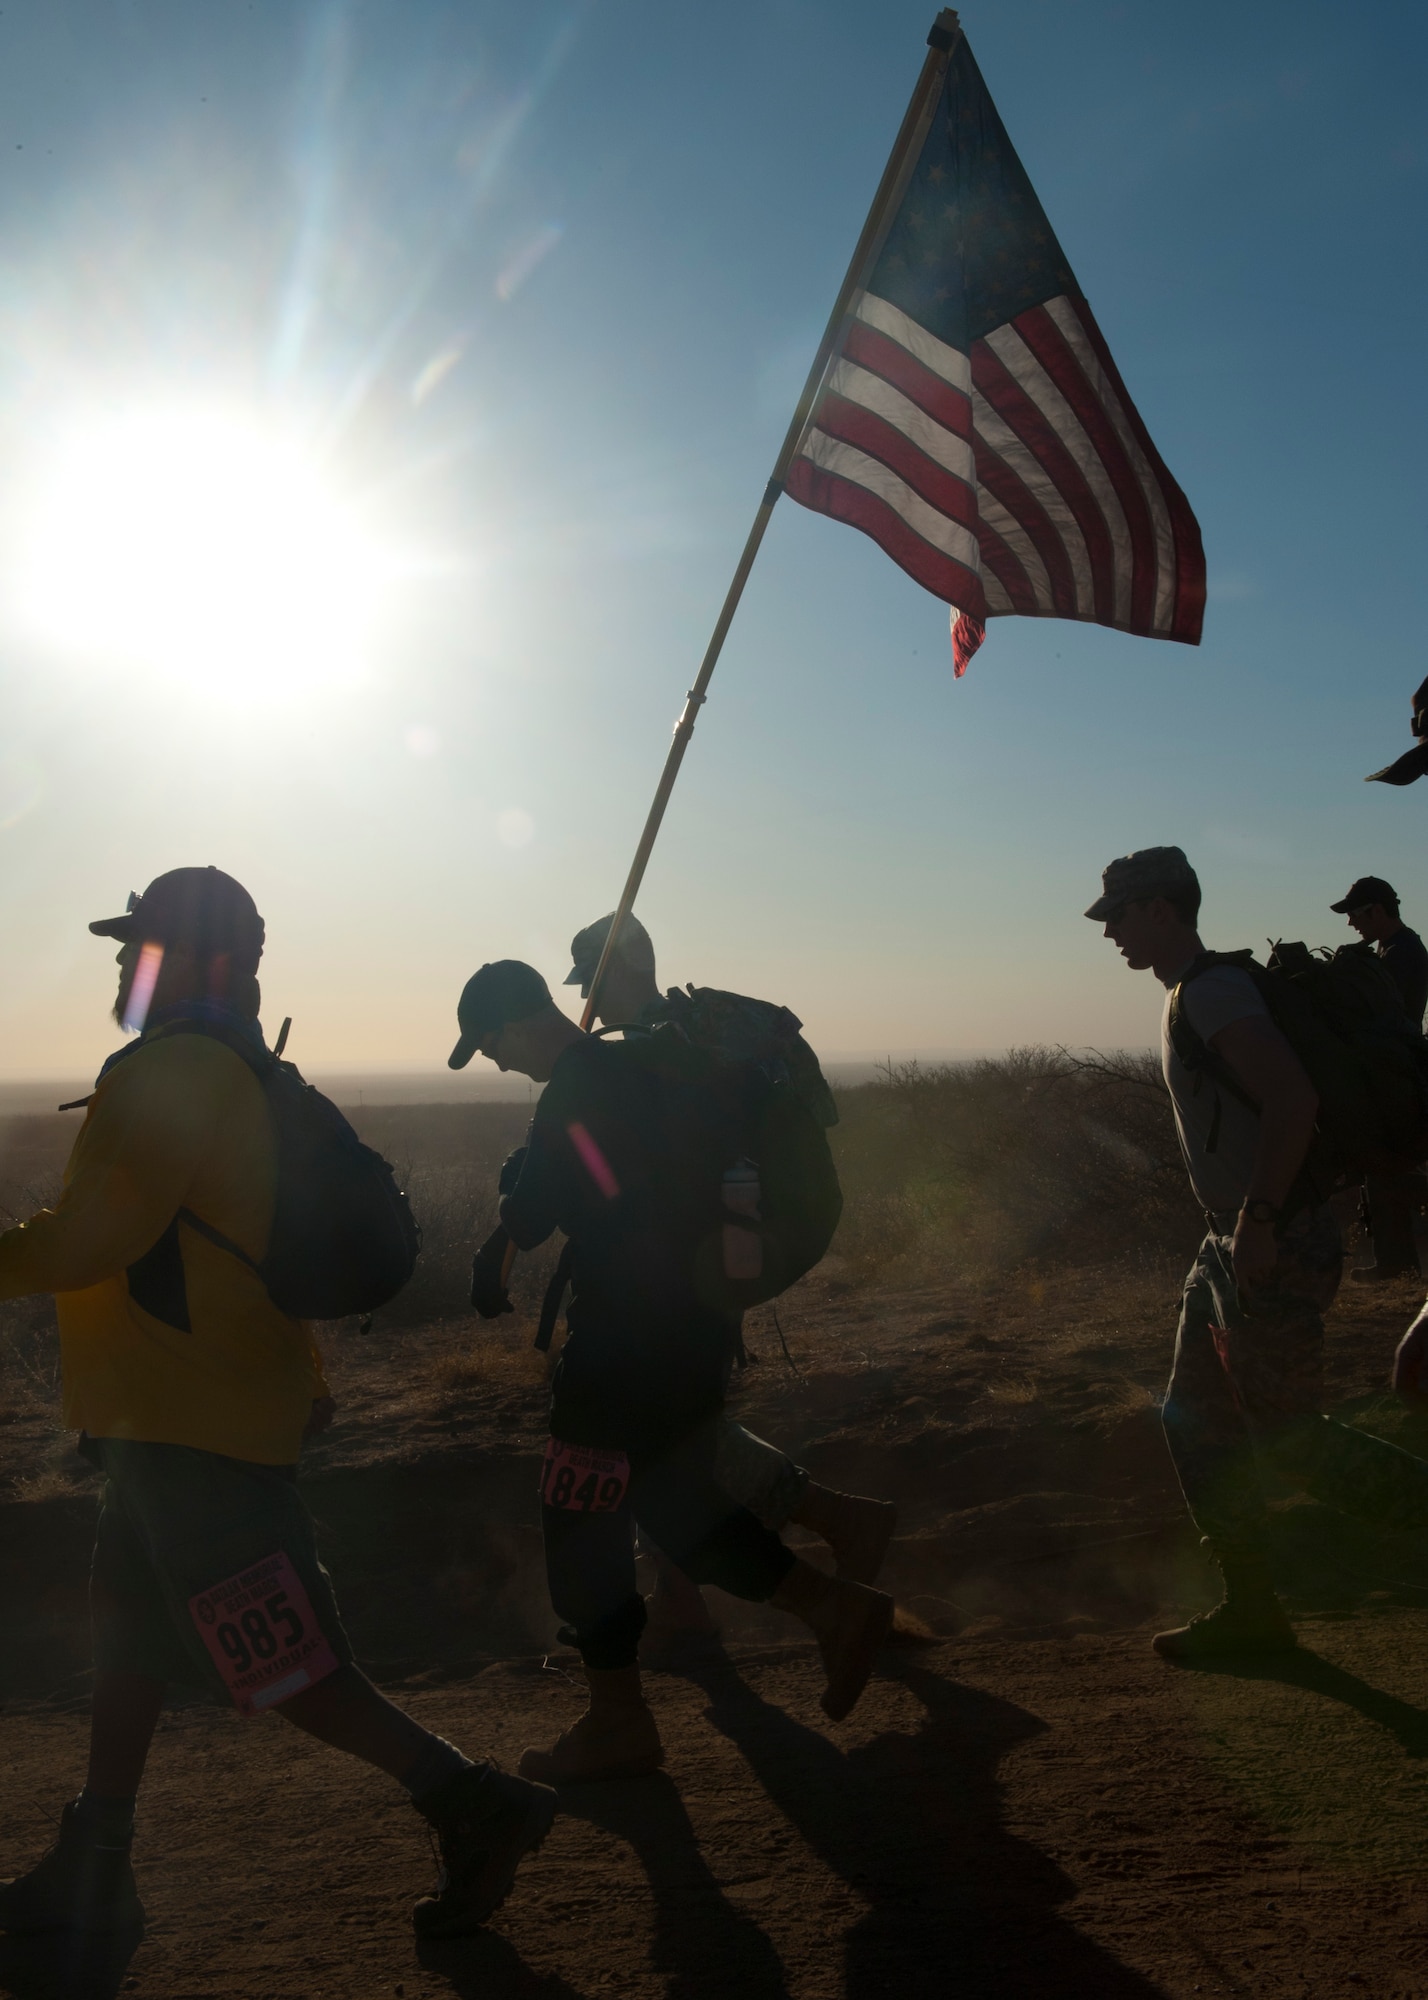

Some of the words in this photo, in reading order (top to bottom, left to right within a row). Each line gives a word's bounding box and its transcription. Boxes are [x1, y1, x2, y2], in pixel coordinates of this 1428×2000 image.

[541, 1458, 623, 1511] 1849
[224, 1590, 252, 1615] DEATH
[217, 1590, 304, 1673] 985
